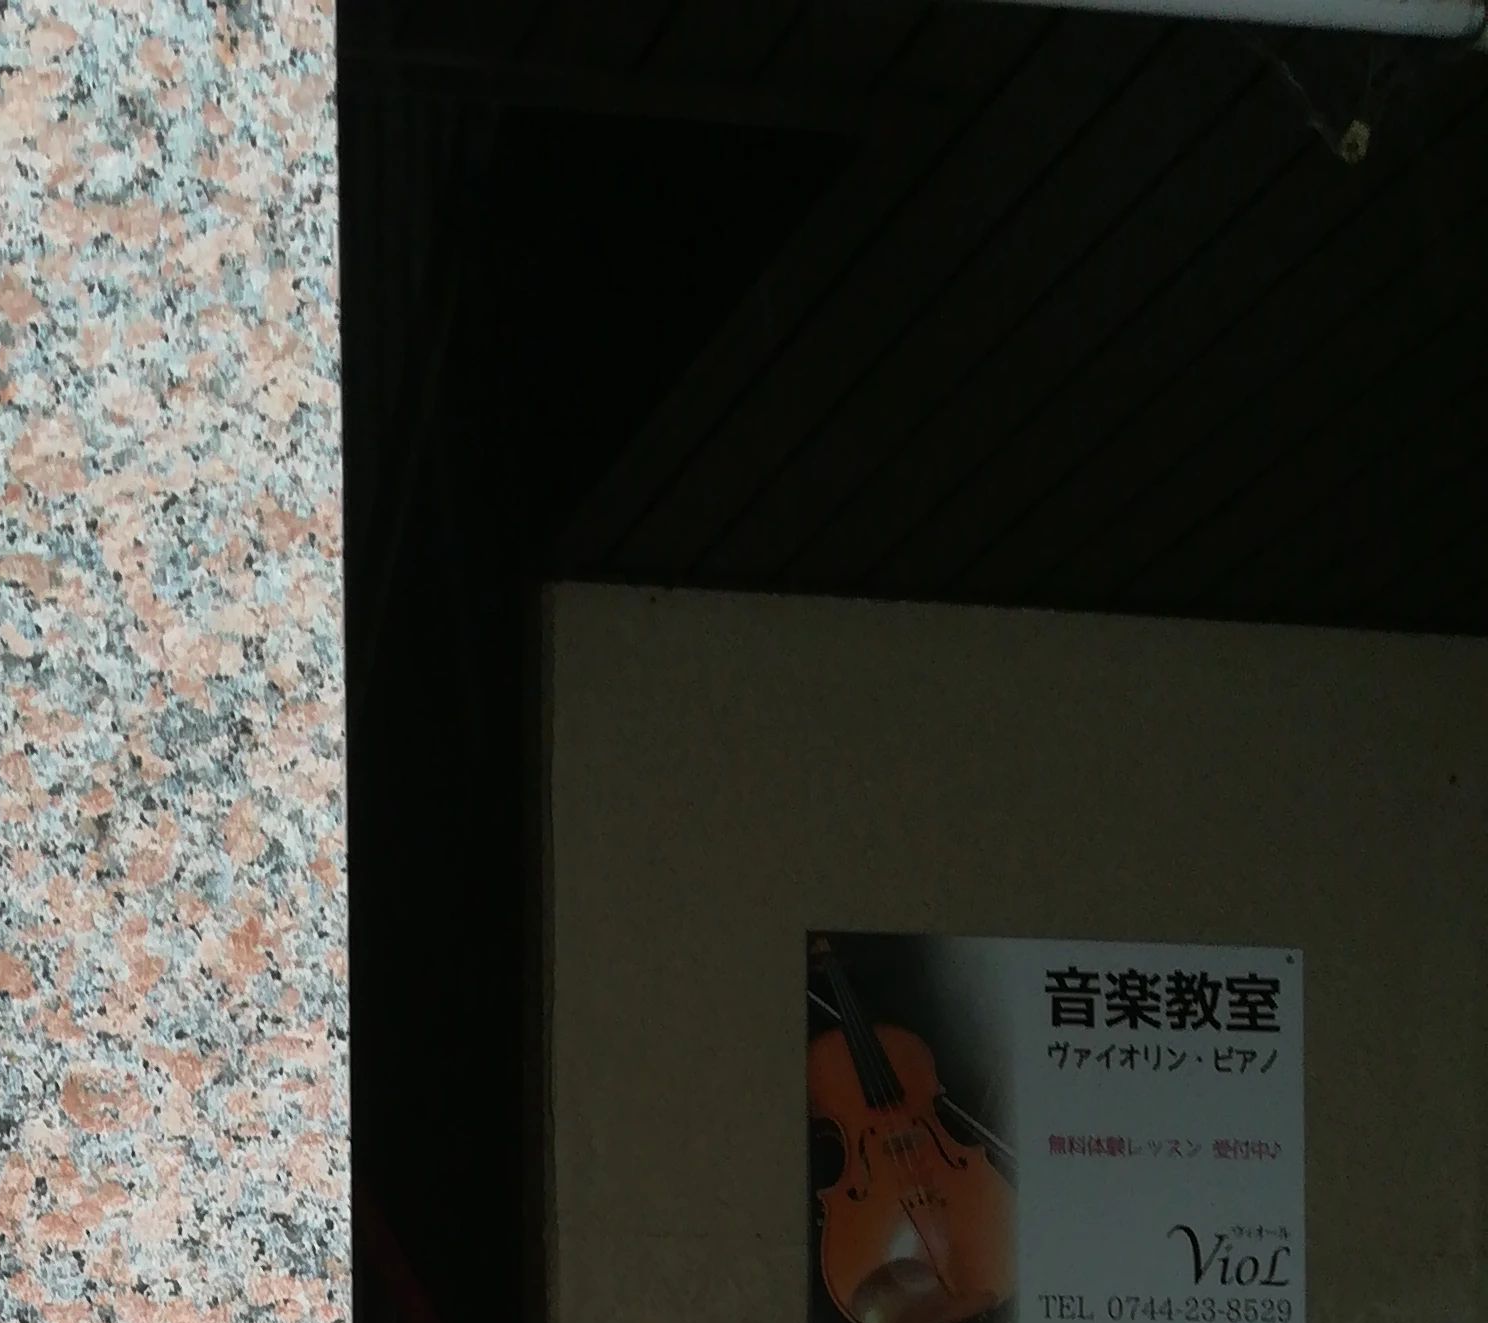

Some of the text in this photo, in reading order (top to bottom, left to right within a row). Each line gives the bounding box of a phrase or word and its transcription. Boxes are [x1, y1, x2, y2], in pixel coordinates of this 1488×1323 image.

[1044, 966, 1281, 1032] 音楽教室
[1047, 1041, 1279, 1073] ヴァイオリン・ピアノ
[1038, 1295, 1293, 1323] TEL 0744-23-8529
